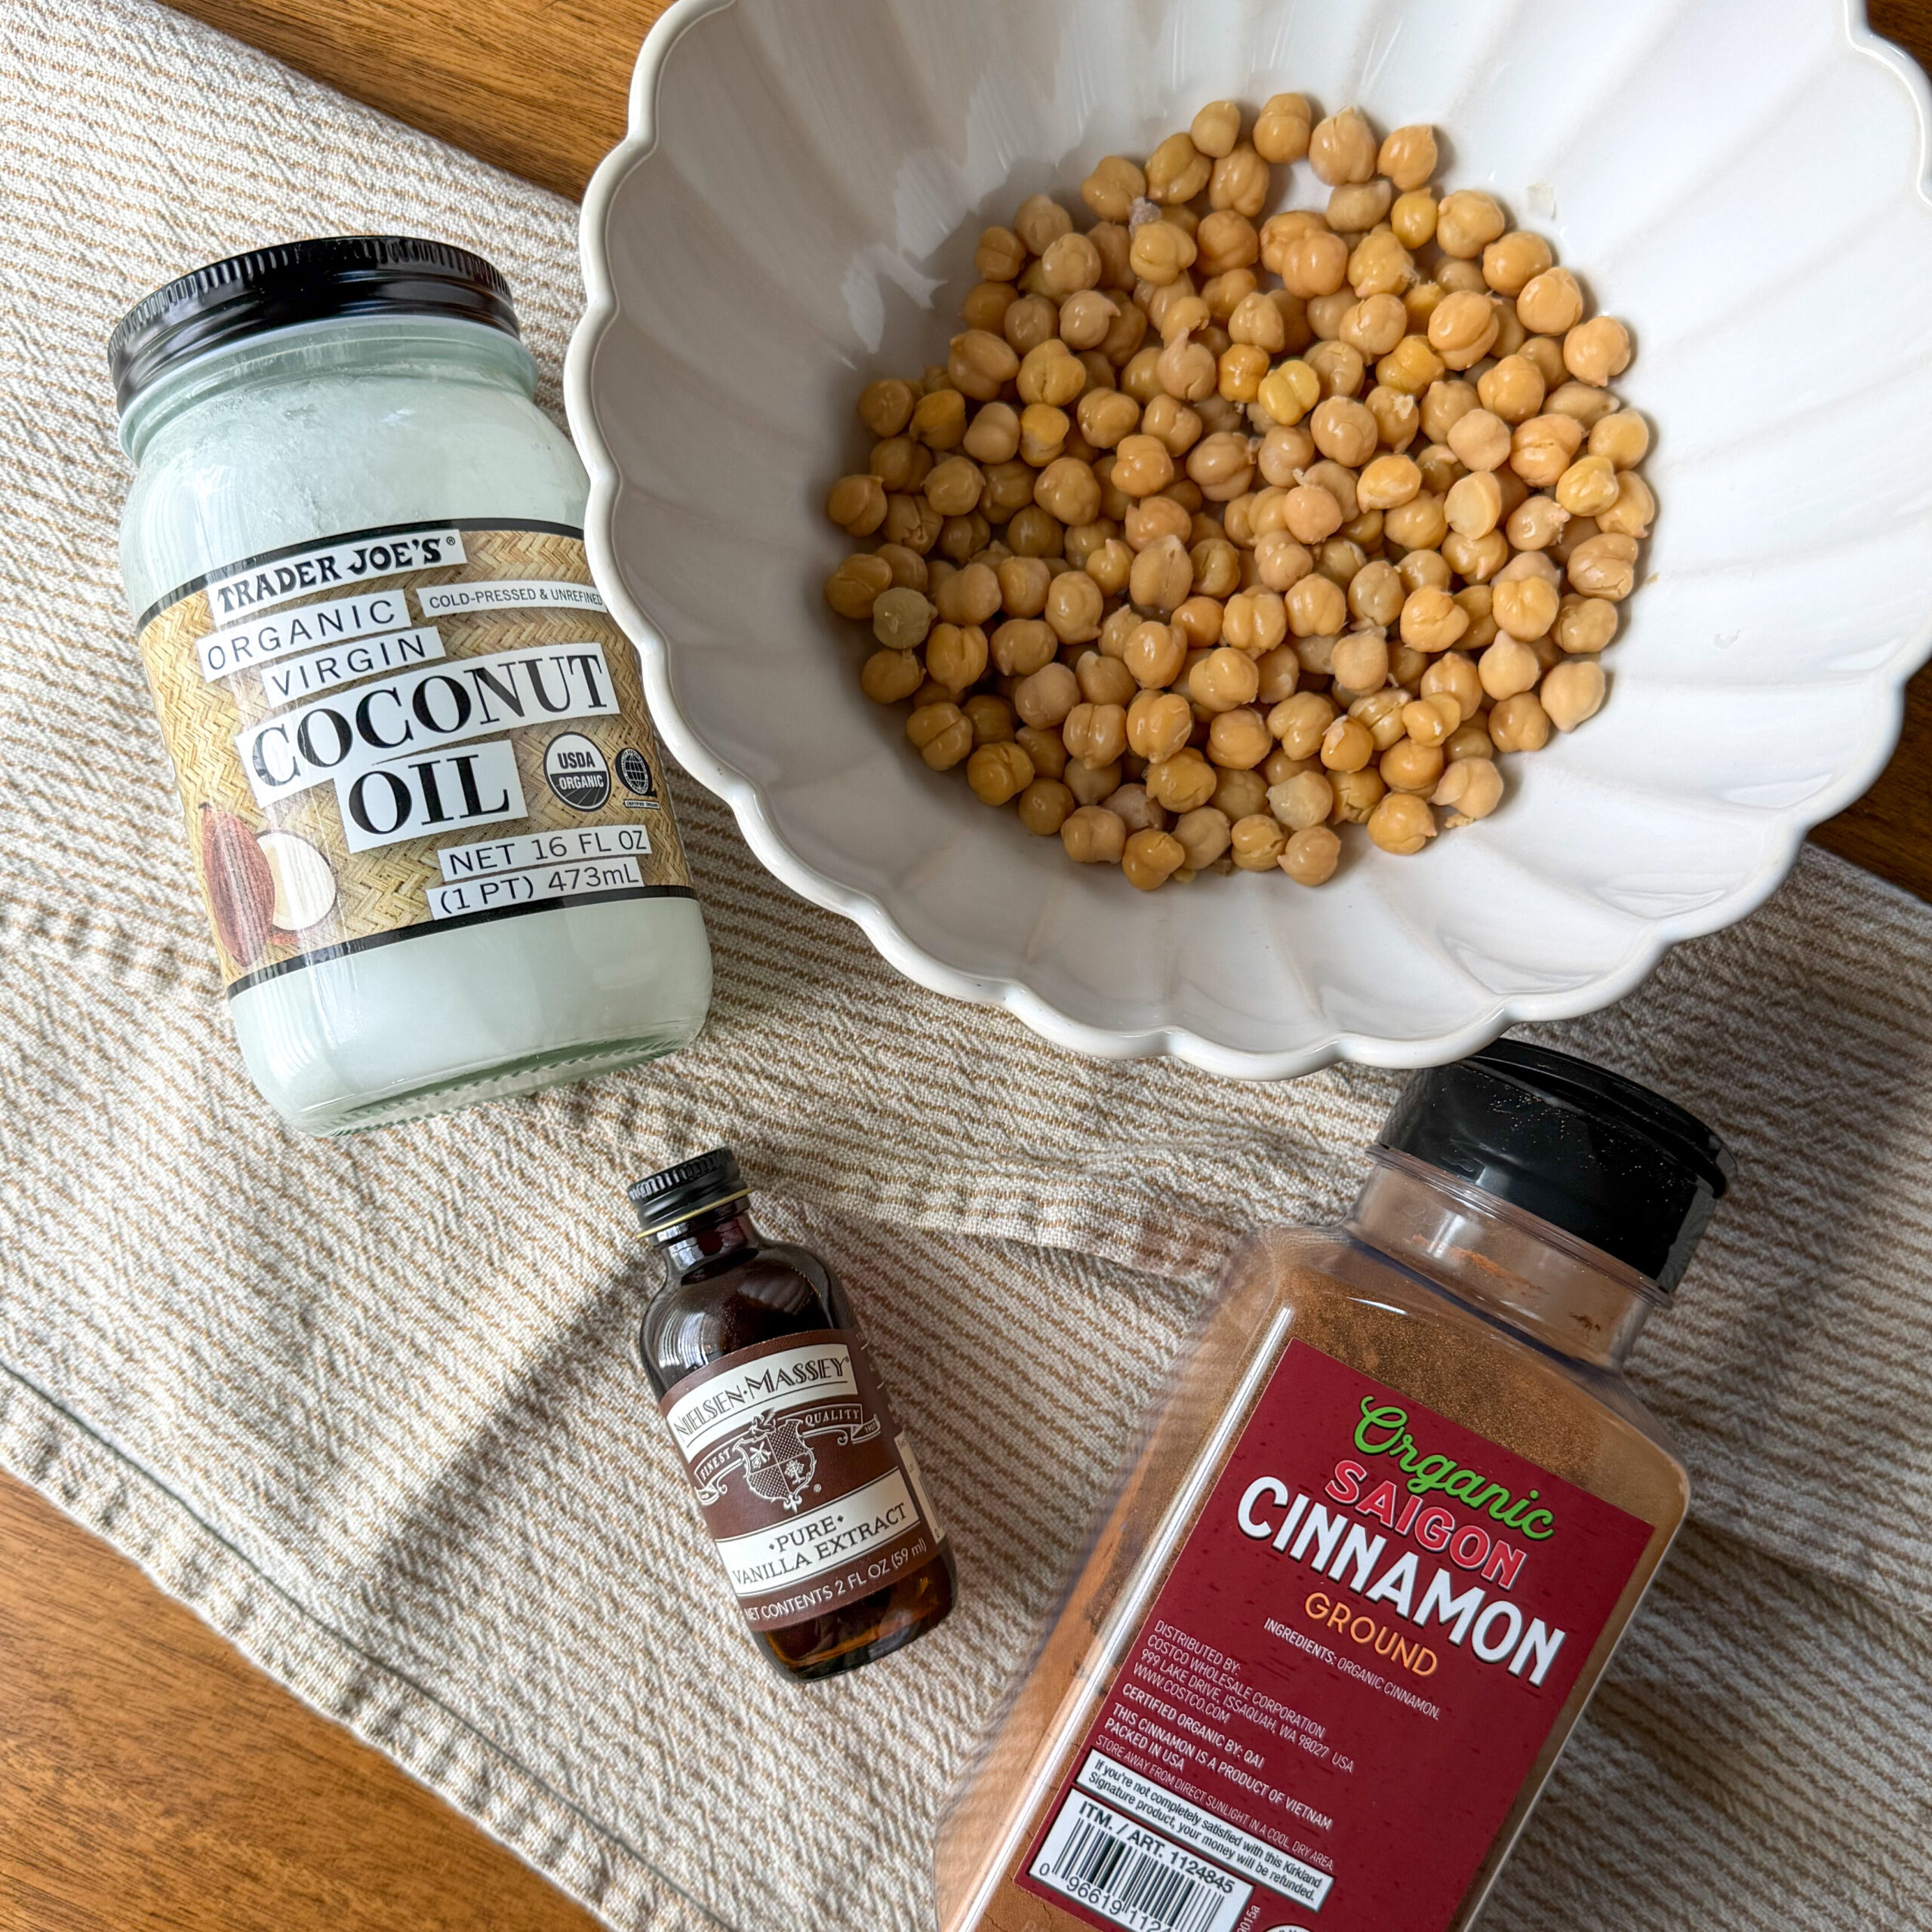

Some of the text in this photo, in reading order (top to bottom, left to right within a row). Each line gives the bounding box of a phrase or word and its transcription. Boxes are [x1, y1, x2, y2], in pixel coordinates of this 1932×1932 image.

[217, 555, 342, 613] TRADER
[429, 589, 602, 609] COLD-PRESSED & UNREFINED
[208, 601, 395, 669] ORGANIC
[272, 635, 426, 696] VIRGIN
[253, 654, 608, 786] COCONUT
[557, 751, 595, 769] USDA
[349, 755, 509, 835] OIL
[559, 774, 604, 790] ORGANIC
[441, 864, 639, 914] (1 PT) 473mL
[449, 830, 647, 875] NET 16 FL OZ
[700, 1409, 859, 1480] FINEST QUALITY
[1354, 1395, 1555, 1540] Organic
[732, 1503, 906, 1585] VANILLA EXTRACT
[1324, 1460, 1526, 1590] SAIGON
[745, 1607, 760, 1621] NET
[761, 1585, 833, 1619] CONTENTS
[837, 1580, 846, 1595] 2
[848, 1572, 866, 1589] FL
[868, 1558, 891, 1579] OZ
[891, 1548, 909, 1570] (59
[1238, 1476, 1566, 1687] CINNAMON
[1154, 1620, 1241, 1676] DISTRIBUTED BY:
[1264, 1617, 1440, 1721] INGREDIENTS: ORGANIC CINNAMON.
[1304, 1592, 1438, 1677] GROUND
[1122, 1683, 1265, 1768] CERTIFIED ORGANIC BY: QAI
[1133, 1662, 1230, 1724] WWW.COSTCO.COM
[1141, 1648, 1161, 1666] 999
[1159, 1660, 1189, 1684] LAKE
[1279, 1724, 1297, 1743] WA
[1298, 1734, 1330, 1758] 98027
[1331, 1752, 1354, 1773] USA
[1147, 1634, 1326, 1740] COSTCO WHOLESALE CORPORATION
[1104, 1718, 1185, 1771] PACKED IN USA
[1112, 1702, 1333, 1830] THIS CINNAMON IS A PRODUCT OF VIETNAM
[1094, 1758, 1323, 1889] If you're not completely satisfied with this Kirkland
[1095, 1734, 1126, 1758] STORE
[1123, 1751, 1151, 1771] AWAY
[1149, 1764, 1176, 1786] FROM
[1174, 1778, 1208, 1802] DIRECT
[1205, 1795, 1251, 1826] SUNLIGHT
[1248, 1818, 1260, 1832] IN
[1258, 1824, 1266, 1836] A
[1291, 1841, 1312, 1857] DRY
[1079, 1801, 1112, 1831] ITM.
[1127, 1829, 1166, 1858] ART.
[1171, 1851, 1235, 1894] 1124845
[1088, 1771, 1315, 1902] Signature product, your money will be refunded.
[1039, 1863, 1050, 1876] 0
[1066, 1876, 1122, 1915] 96619
